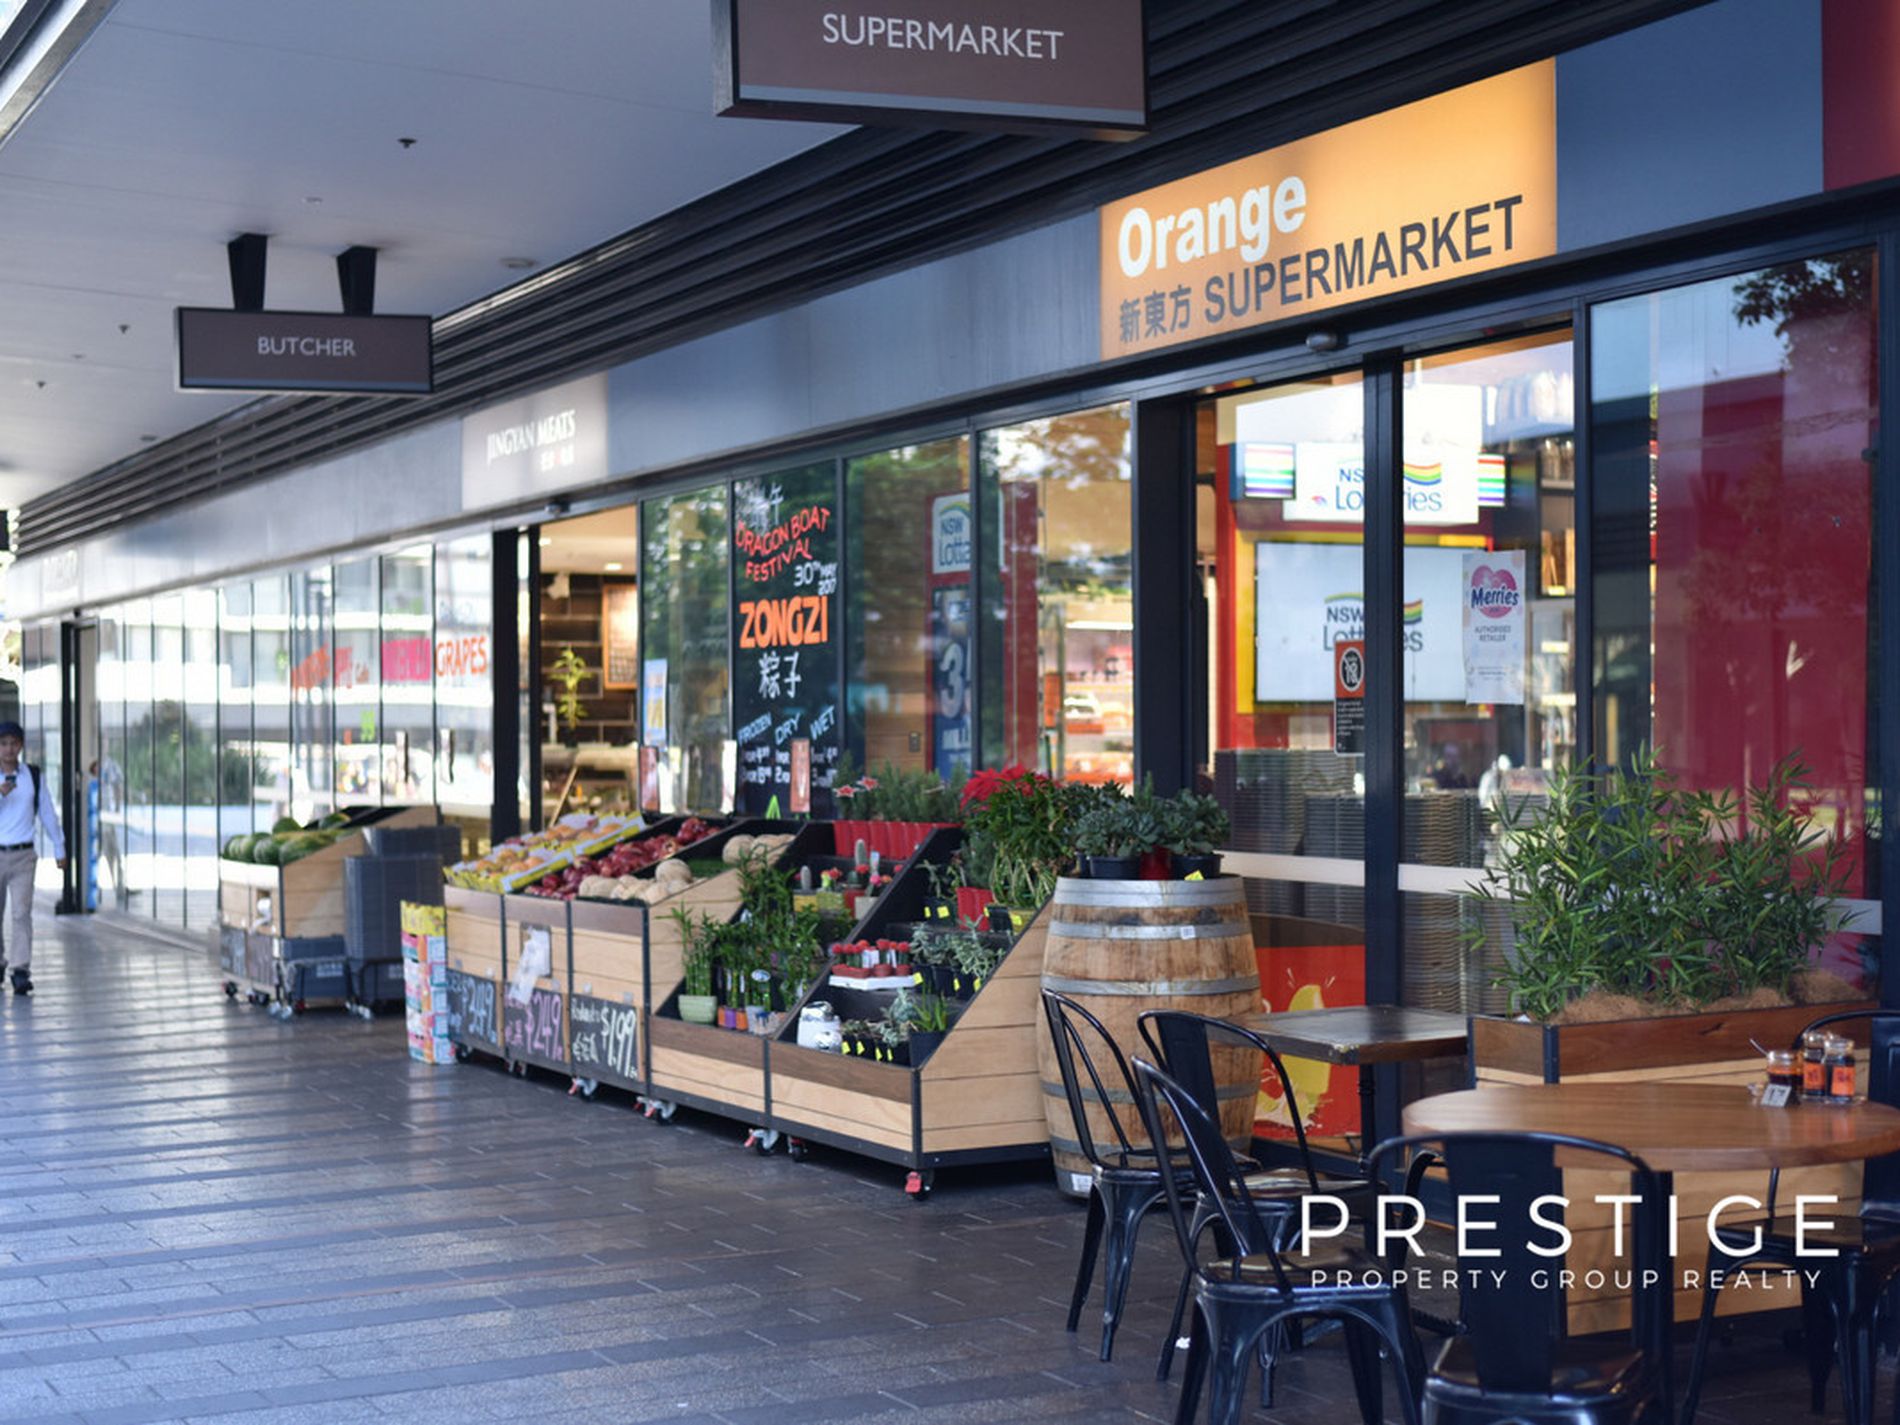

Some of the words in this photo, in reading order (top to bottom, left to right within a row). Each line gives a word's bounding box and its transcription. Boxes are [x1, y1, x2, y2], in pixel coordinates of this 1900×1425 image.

[822, 13, 1065, 60] SUPERMARKET
[1117, 175, 1307, 279] Orange
[1203, 194, 1523, 324] SUPERMARKET
[1119, 283, 1192, 344] 新東方
[257, 335, 357, 359] BUTCHER
[536, 408, 576, 447] MEATS
[1339, 466, 1364, 483] NS
[735, 518, 790, 557] DRAGON
[790, 504, 831, 540] BOAT
[746, 537, 813, 583] FESTIVAL
[1470, 584, 1520, 610] Merries
[739, 594, 829, 649] ZONGZI
[434, 633, 488, 678] GRAPES
[774, 712, 801, 746] DRY
[810, 704, 835, 741] WET
